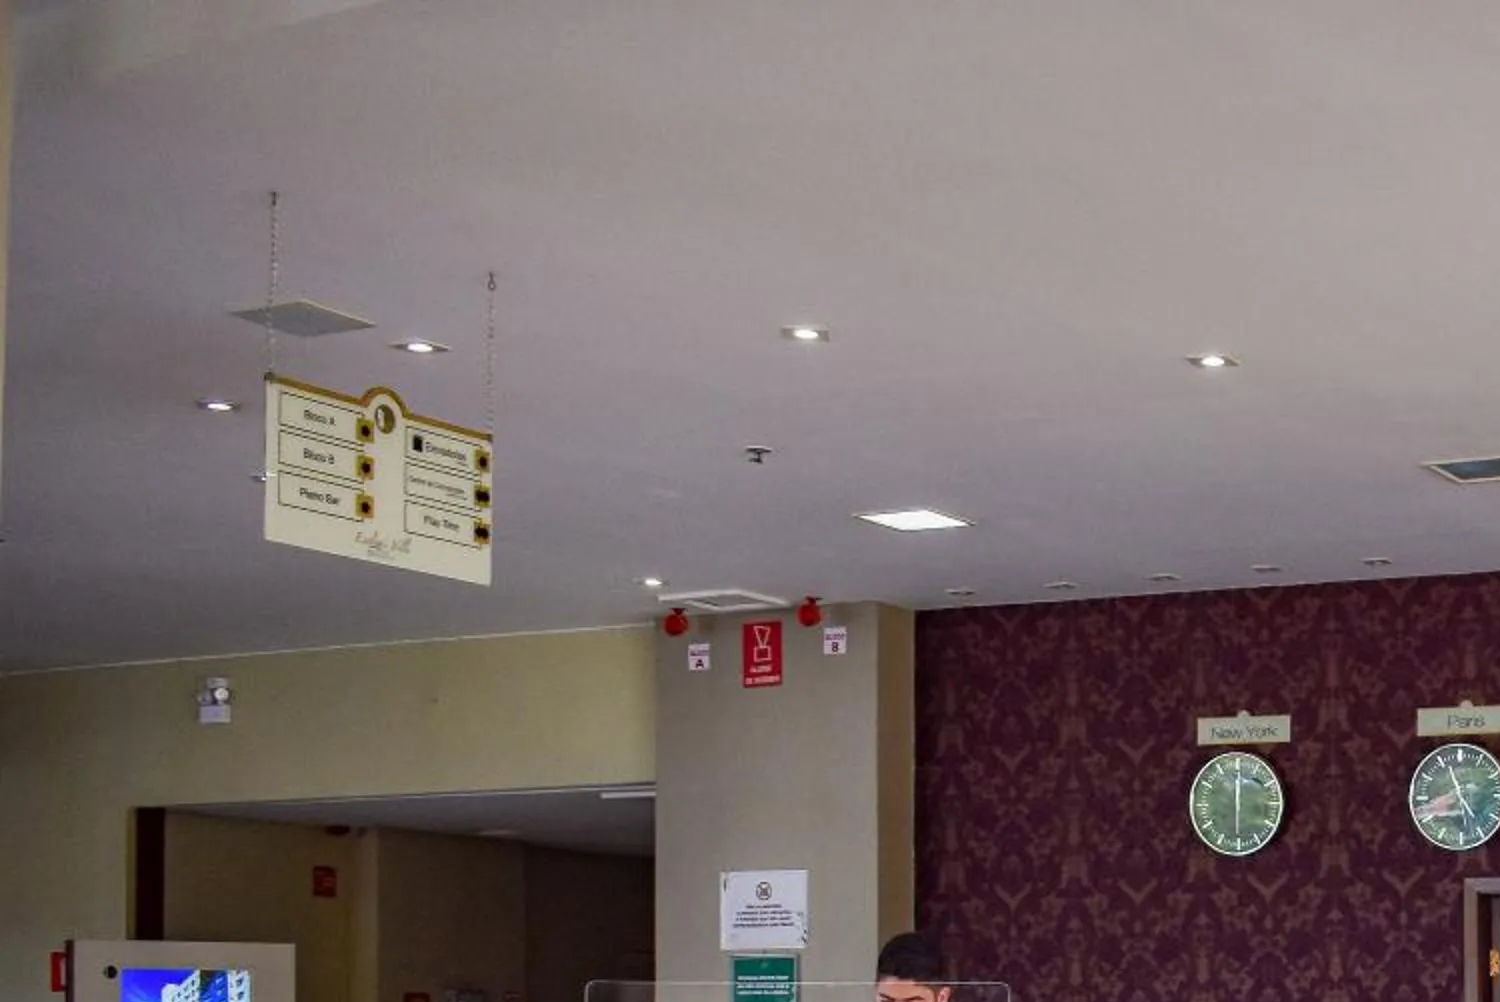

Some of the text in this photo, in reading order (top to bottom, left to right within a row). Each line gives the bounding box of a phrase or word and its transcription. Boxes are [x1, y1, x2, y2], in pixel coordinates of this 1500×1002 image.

[1447, 713, 1486, 730] Paris
[1210, 725, 1280, 740] New York
